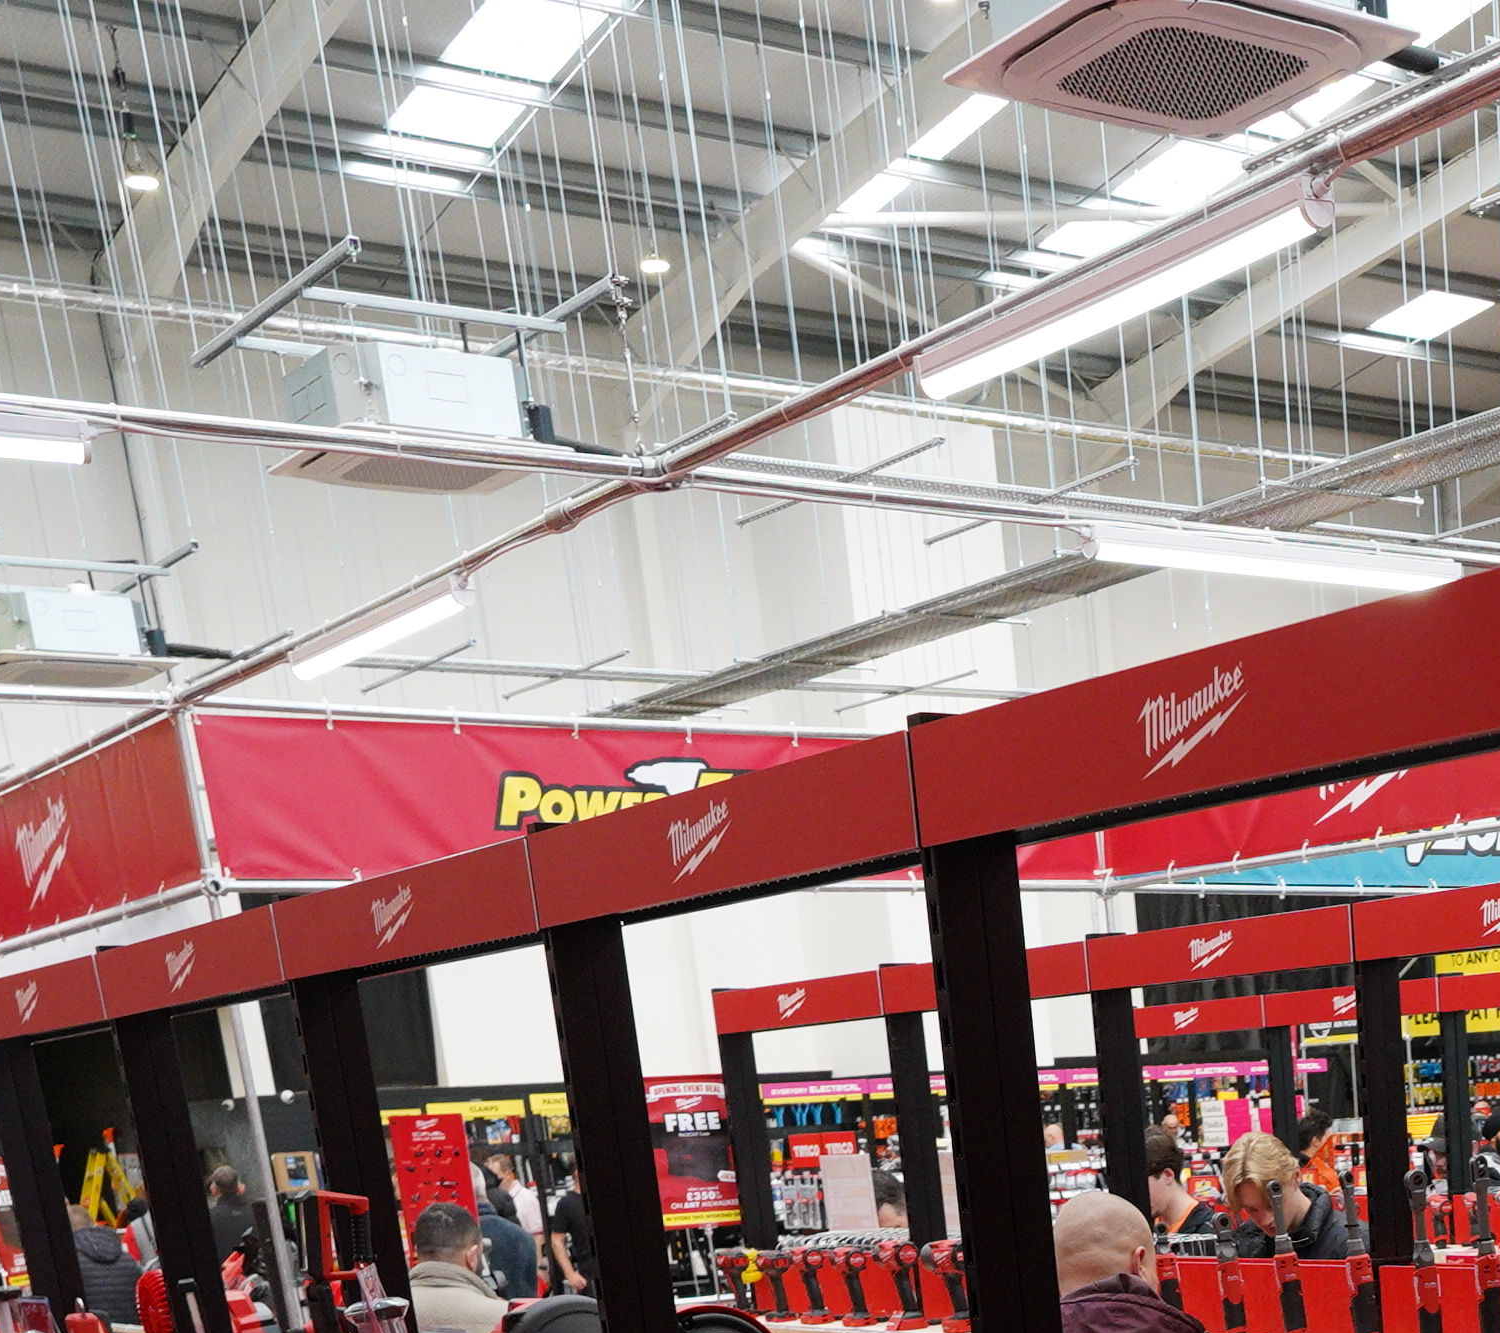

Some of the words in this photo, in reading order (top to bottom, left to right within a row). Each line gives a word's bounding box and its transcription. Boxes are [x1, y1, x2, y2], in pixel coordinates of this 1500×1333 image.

[1138, 661, 1245, 757] Milwaukee
[16, 796, 67, 884] Milwaukee
[667, 799, 728, 864] Milwaukee
[372, 884, 412, 934] Milwaukee
[165, 940, 194, 980] Milwaukee
[1188, 930, 1233, 963] Milwaukee
[1451, 953, 1464, 967] TO
[1466, 951, 1490, 966] ANY
[664, 1112, 721, 1133] FREE
